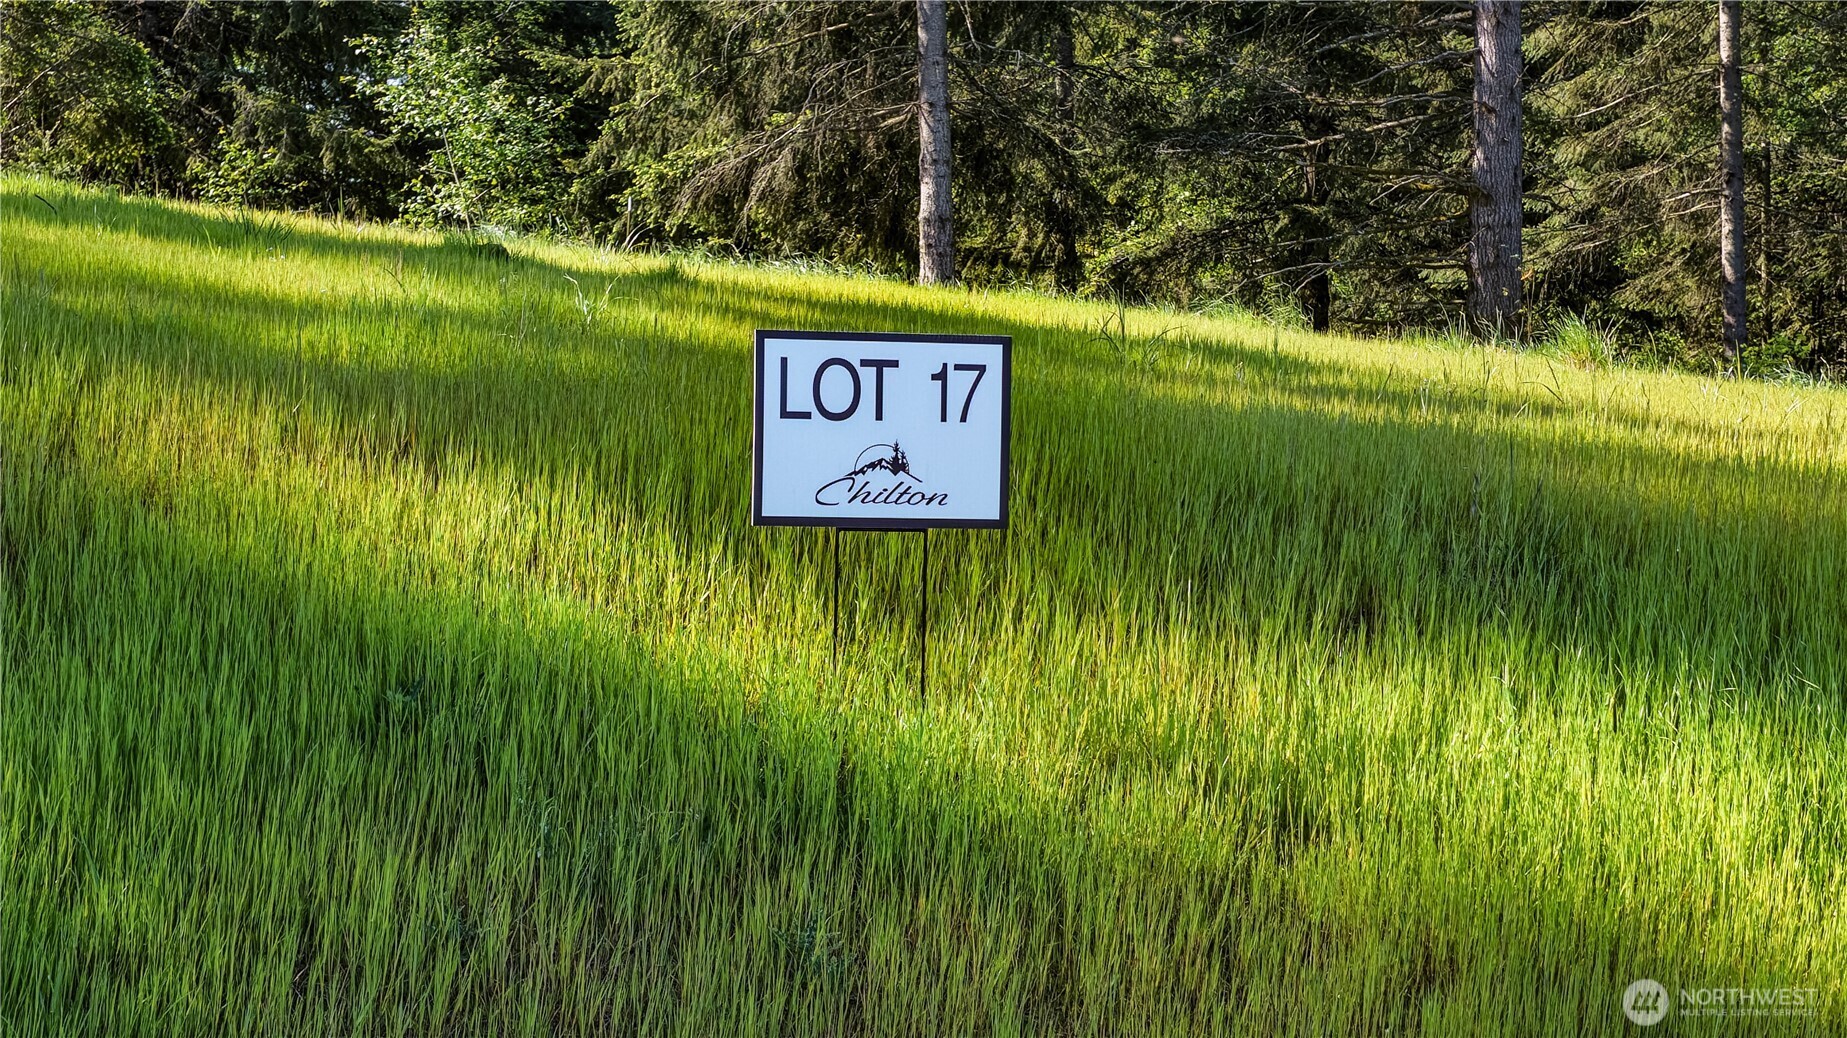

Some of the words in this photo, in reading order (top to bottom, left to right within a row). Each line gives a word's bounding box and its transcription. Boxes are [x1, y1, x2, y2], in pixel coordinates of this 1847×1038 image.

[779, 357, 900, 422] LOT
[930, 362, 987, 423] 17
[814, 477, 948, 506] Chilton
